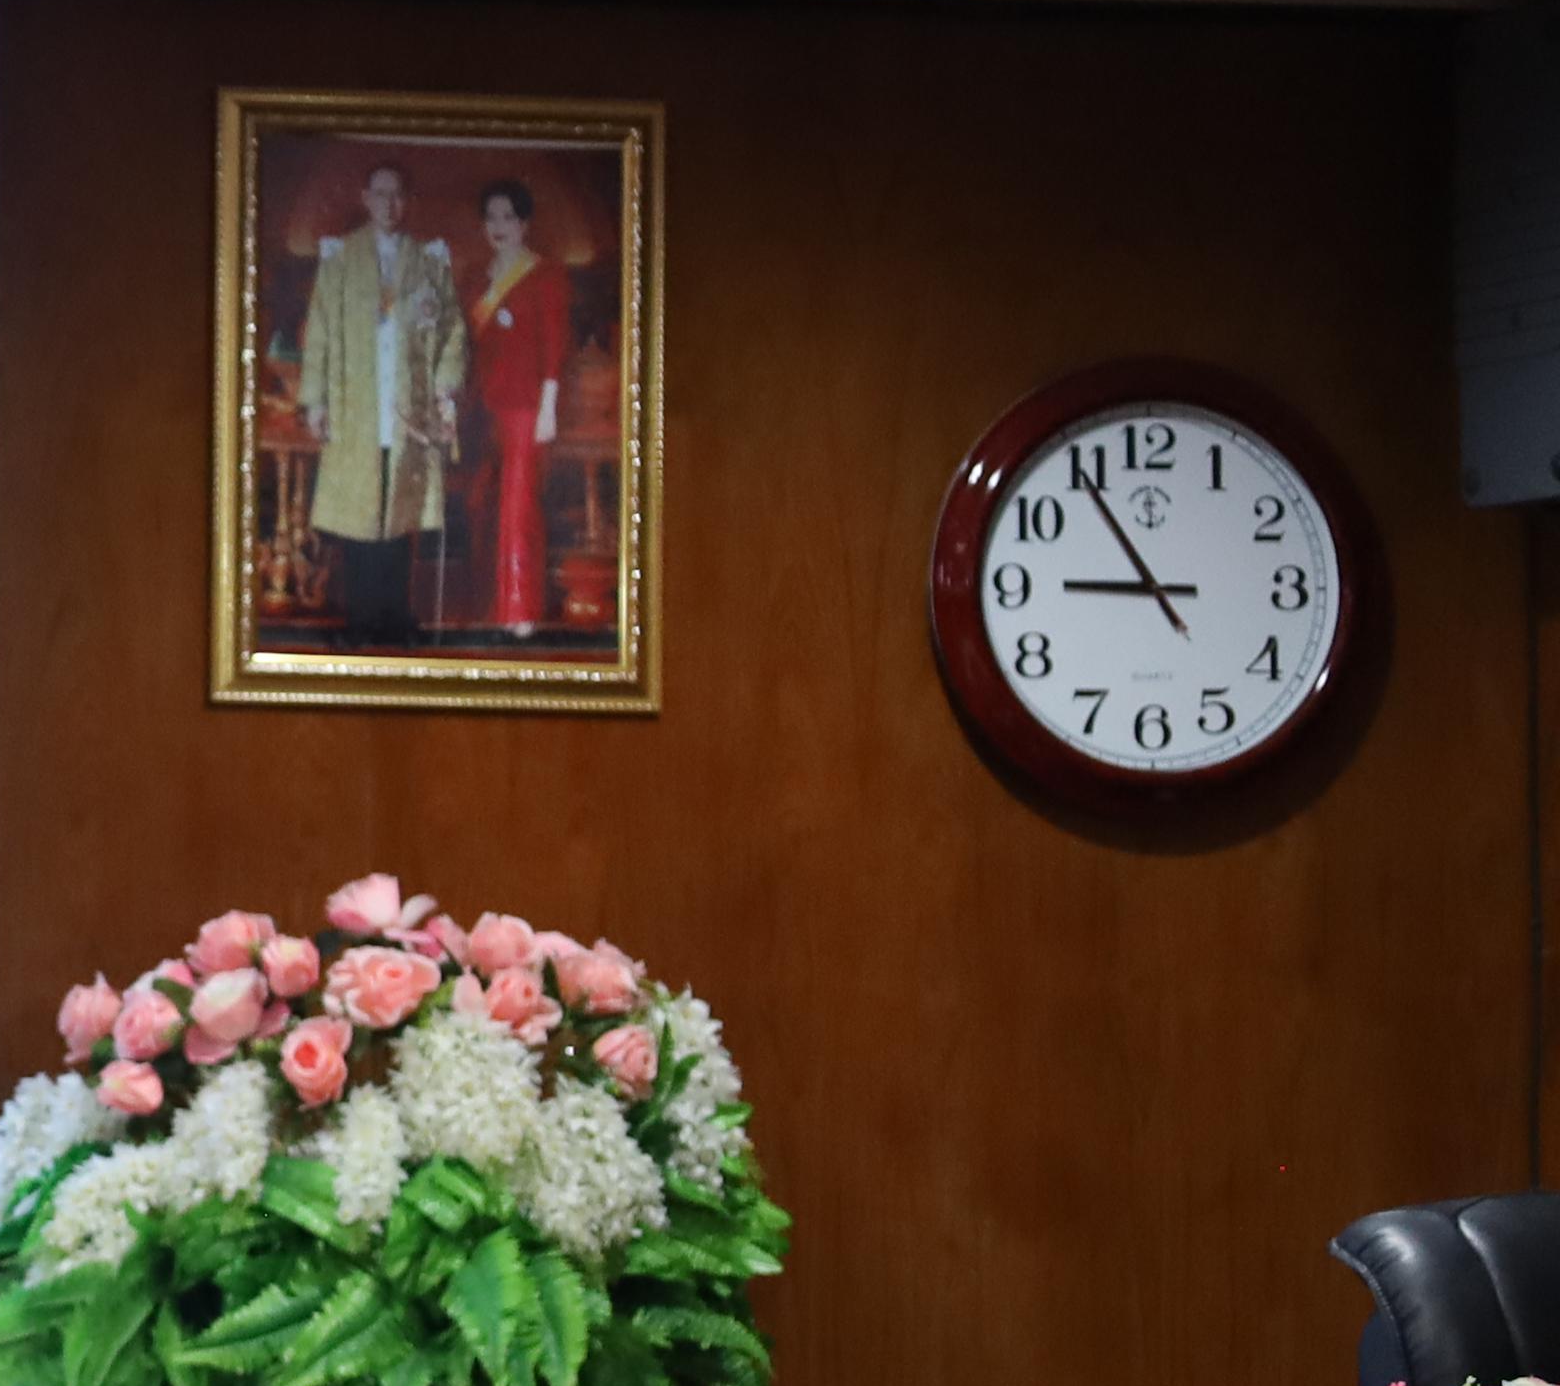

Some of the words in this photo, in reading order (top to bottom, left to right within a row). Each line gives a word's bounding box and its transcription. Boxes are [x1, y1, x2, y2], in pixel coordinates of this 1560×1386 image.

[1066, 444, 1110, 491] 11
[1121, 423, 1177, 470] 12
[1206, 444, 1227, 491] 1
[1016, 495, 1065, 543] 10
[1253, 496, 1286, 543] 2
[993, 562, 1032, 610] 9
[1271, 564, 1310, 612] 3
[1015, 631, 1053, 679] 8
[1246, 635, 1282, 682] 4
[1072, 688, 1110, 735] 7
[1134, 703, 1173, 751] 6
[1198, 688, 1236, 735] 5
